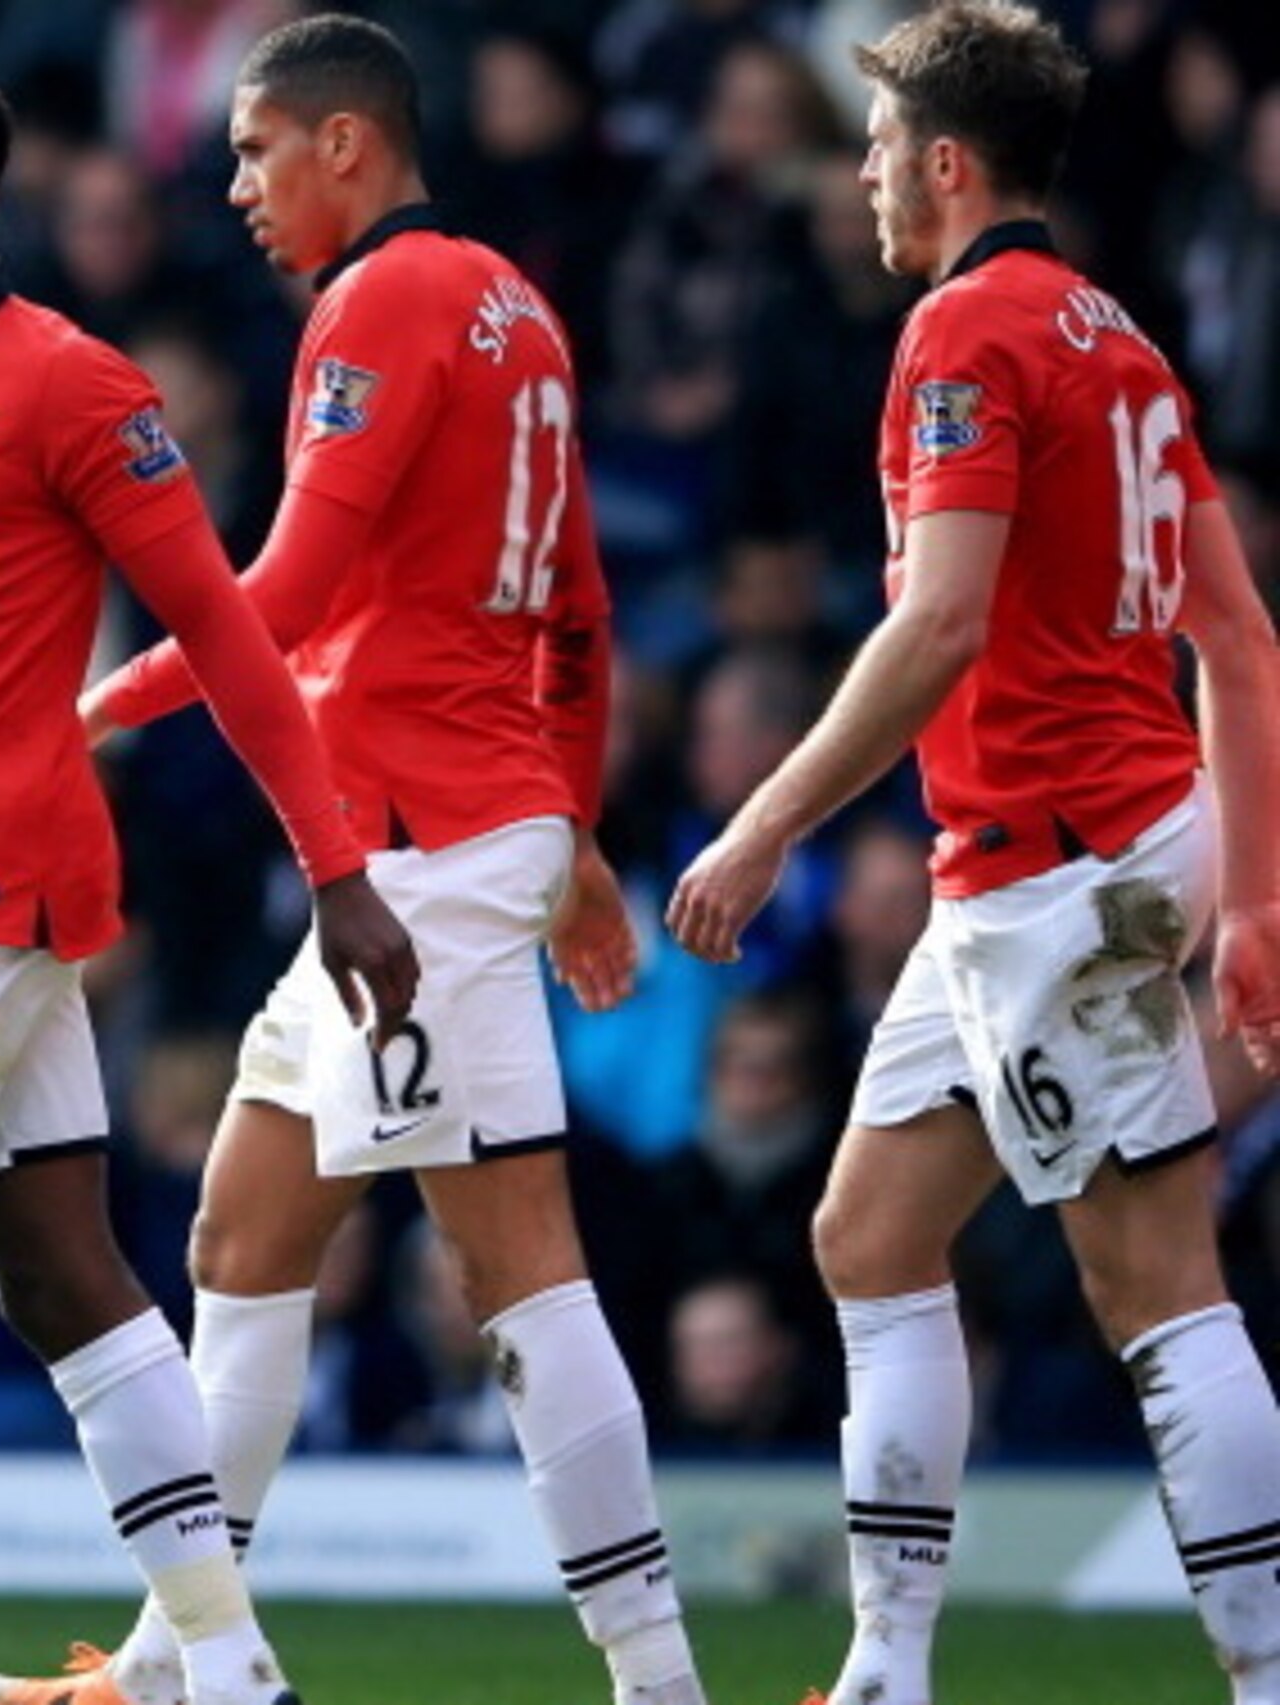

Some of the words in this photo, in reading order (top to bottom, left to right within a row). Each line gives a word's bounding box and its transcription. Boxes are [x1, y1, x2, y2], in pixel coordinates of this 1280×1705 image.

[477, 376, 571, 614] 12
[1109, 388, 1186, 637] 16
[366, 1020, 441, 1116] 12
[1000, 1044, 1074, 1140] 16
